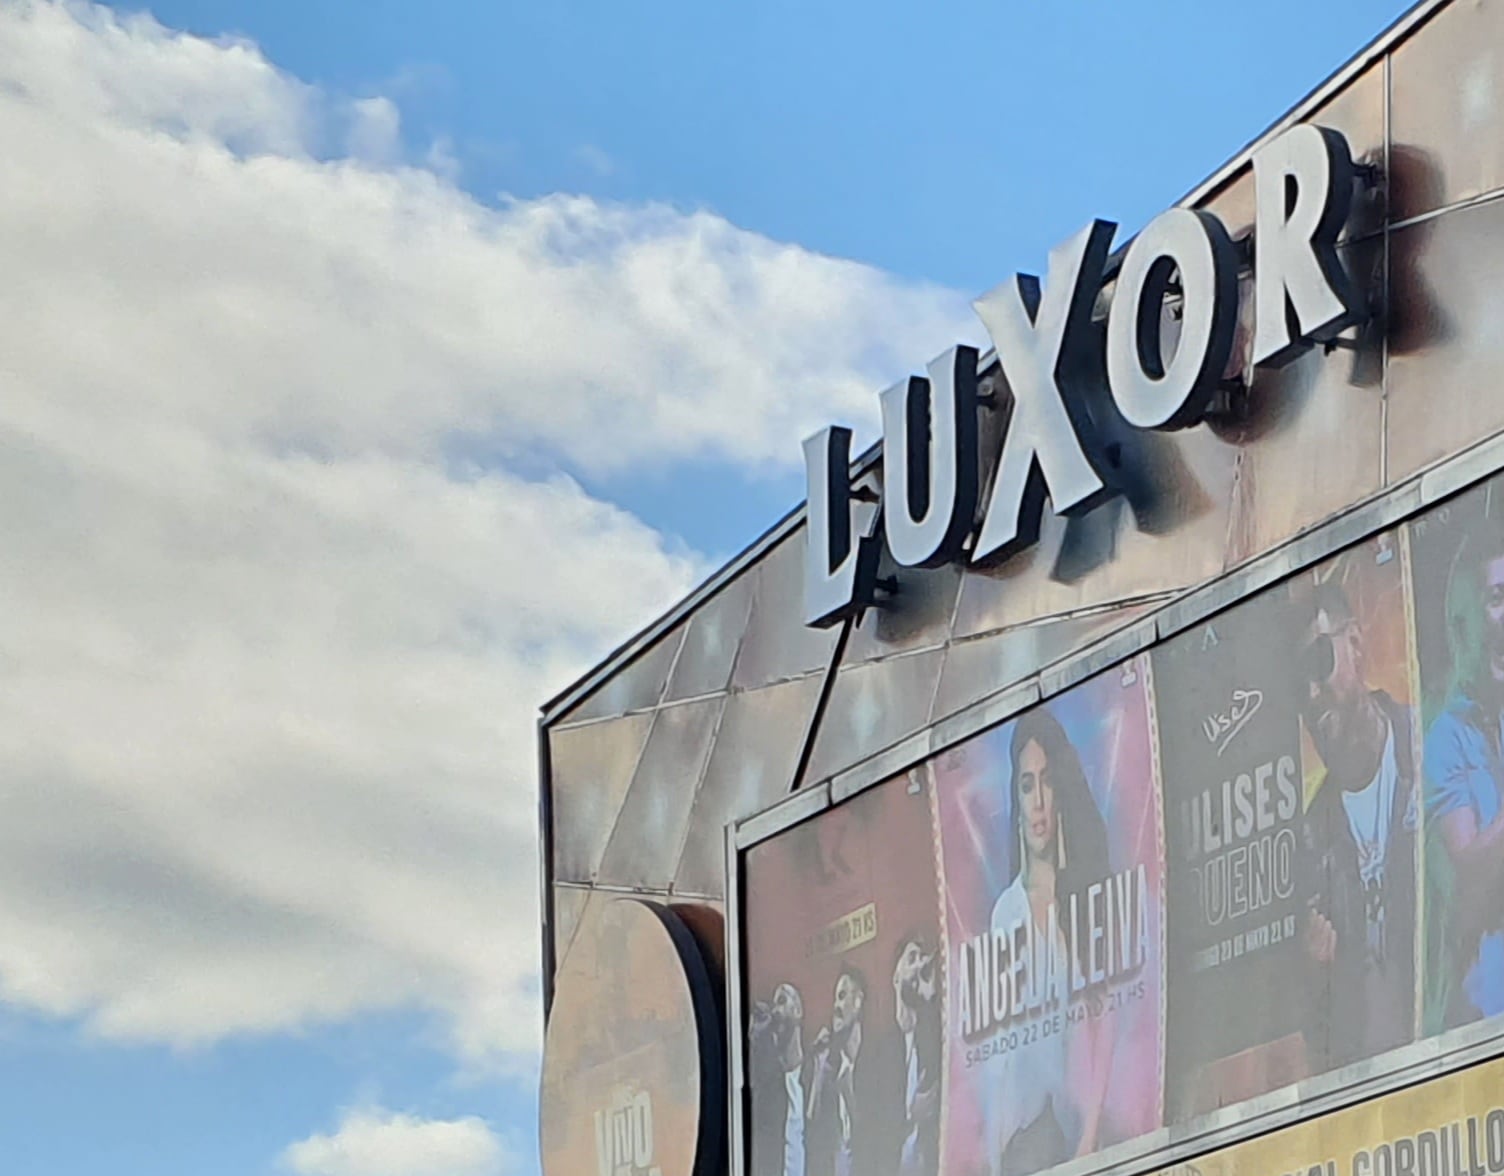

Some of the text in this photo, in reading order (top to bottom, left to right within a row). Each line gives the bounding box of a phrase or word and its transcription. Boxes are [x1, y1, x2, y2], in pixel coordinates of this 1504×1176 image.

[801, 123, 1352, 628] LUXOR
[959, 863, 1151, 1038] ANGELA LEIVA
[1043, 1015, 1061, 1039] DE
